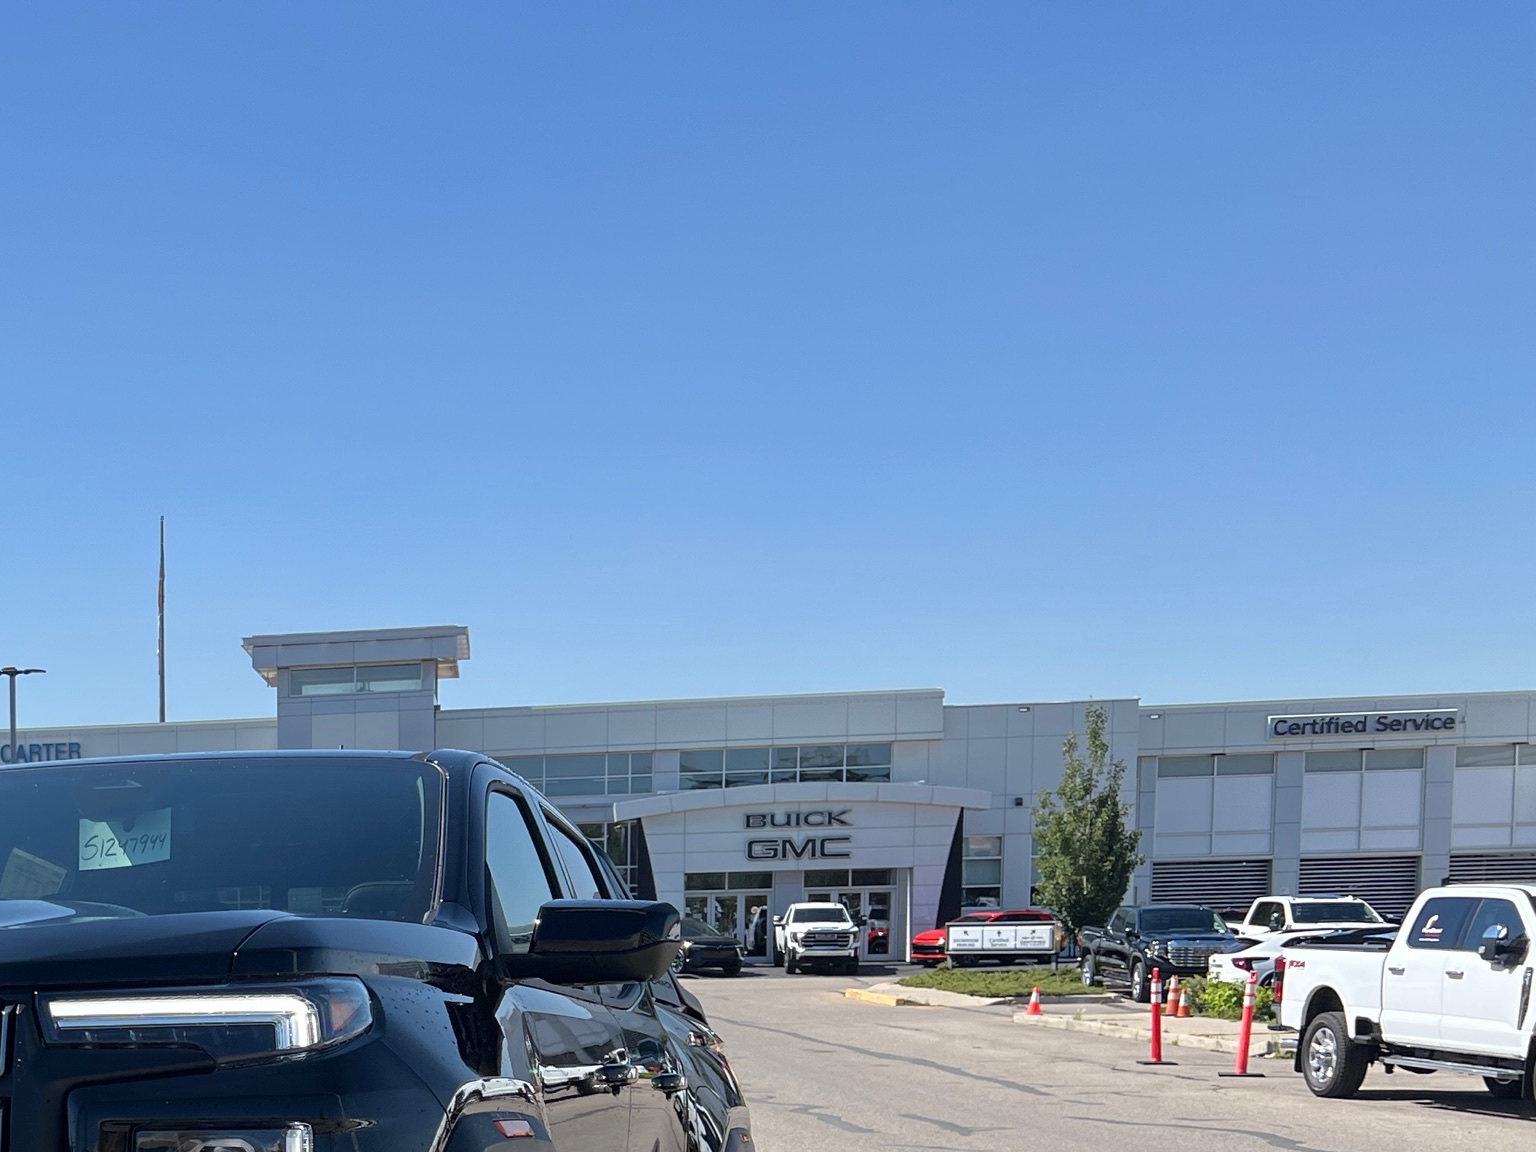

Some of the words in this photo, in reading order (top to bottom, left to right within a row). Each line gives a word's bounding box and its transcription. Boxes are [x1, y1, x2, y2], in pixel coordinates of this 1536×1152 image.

[1274, 715, 1366, 736] Certified
[1375, 713, 1455, 733] Service
[0, 742, 82, 764] CARTER
[744, 809, 853, 829] BUICK
[745, 835, 852, 861] GMC
